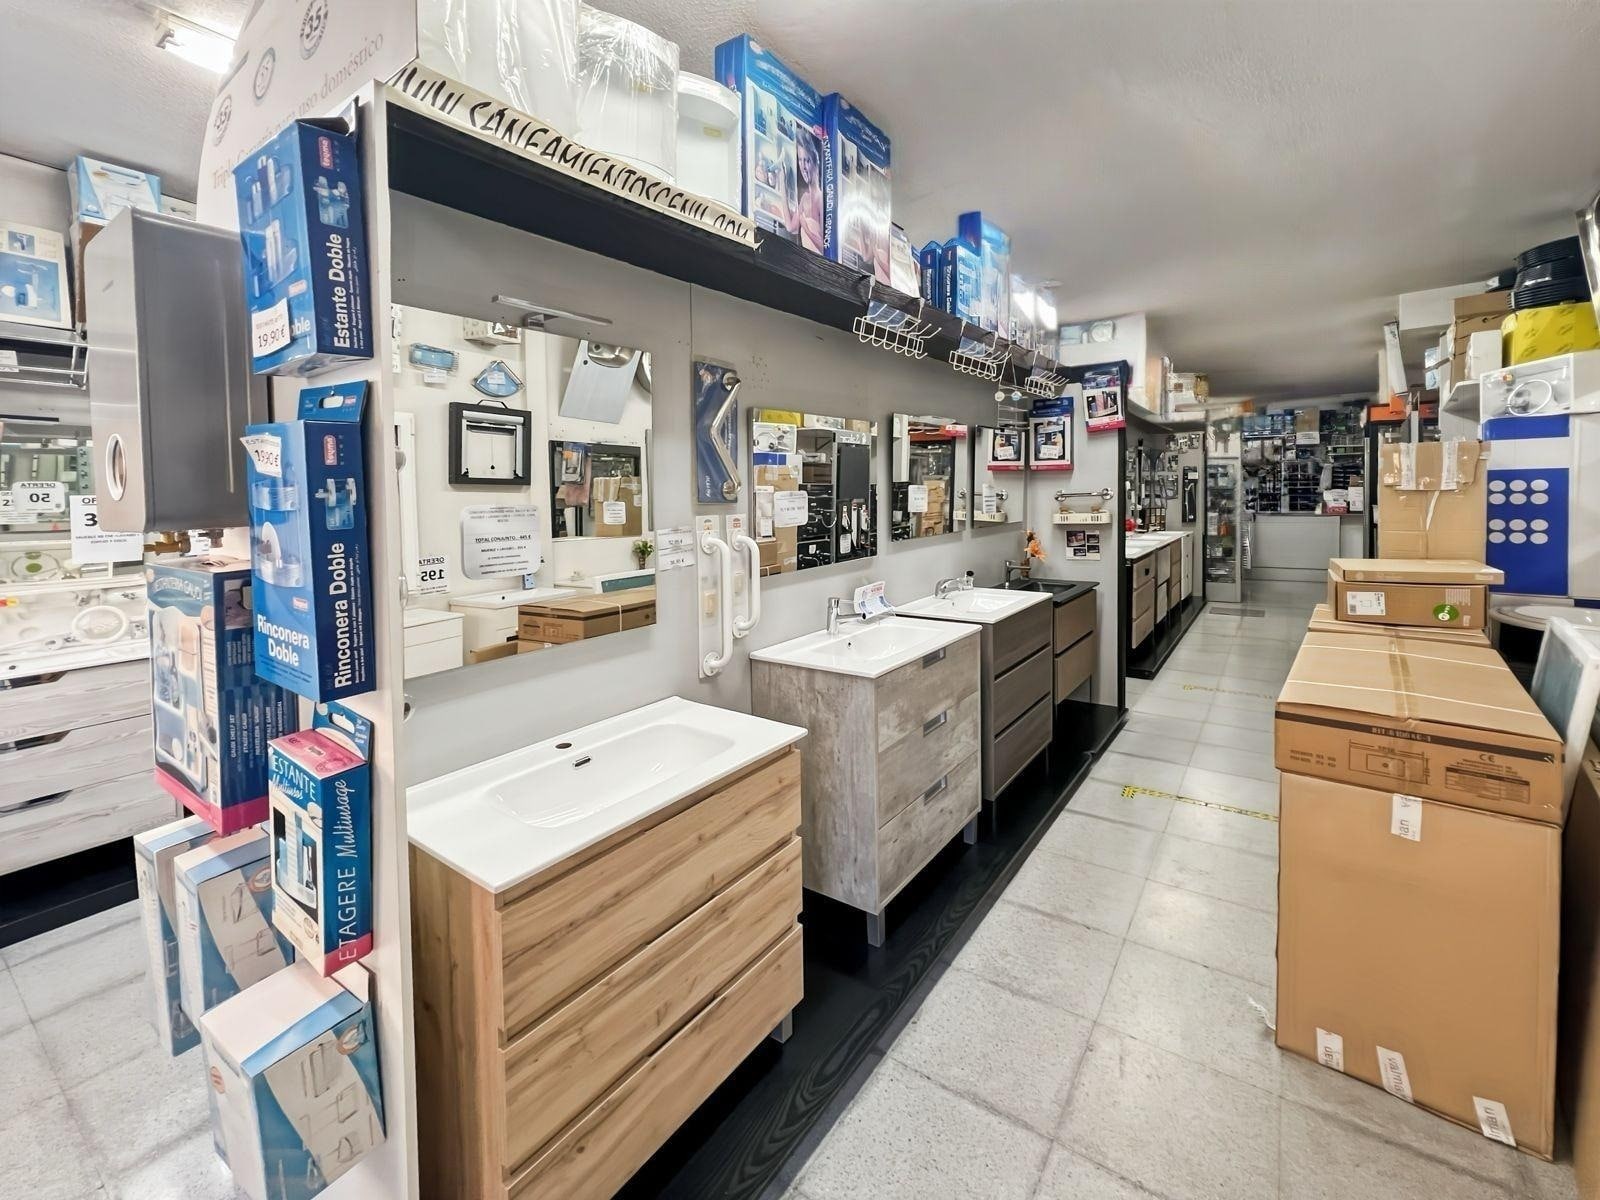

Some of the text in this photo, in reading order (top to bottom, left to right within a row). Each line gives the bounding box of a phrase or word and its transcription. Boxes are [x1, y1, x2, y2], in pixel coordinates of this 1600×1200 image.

[328, 233, 350, 350] Estante Doble
[257, 614, 309, 649] Rinconera
[268, 638, 299, 667] Doble
[329, 543, 352, 688] Rinconera Doble
[272, 755, 316, 802] ESTANTE
[332, 779, 358, 961] ETAGERE Multiusage
